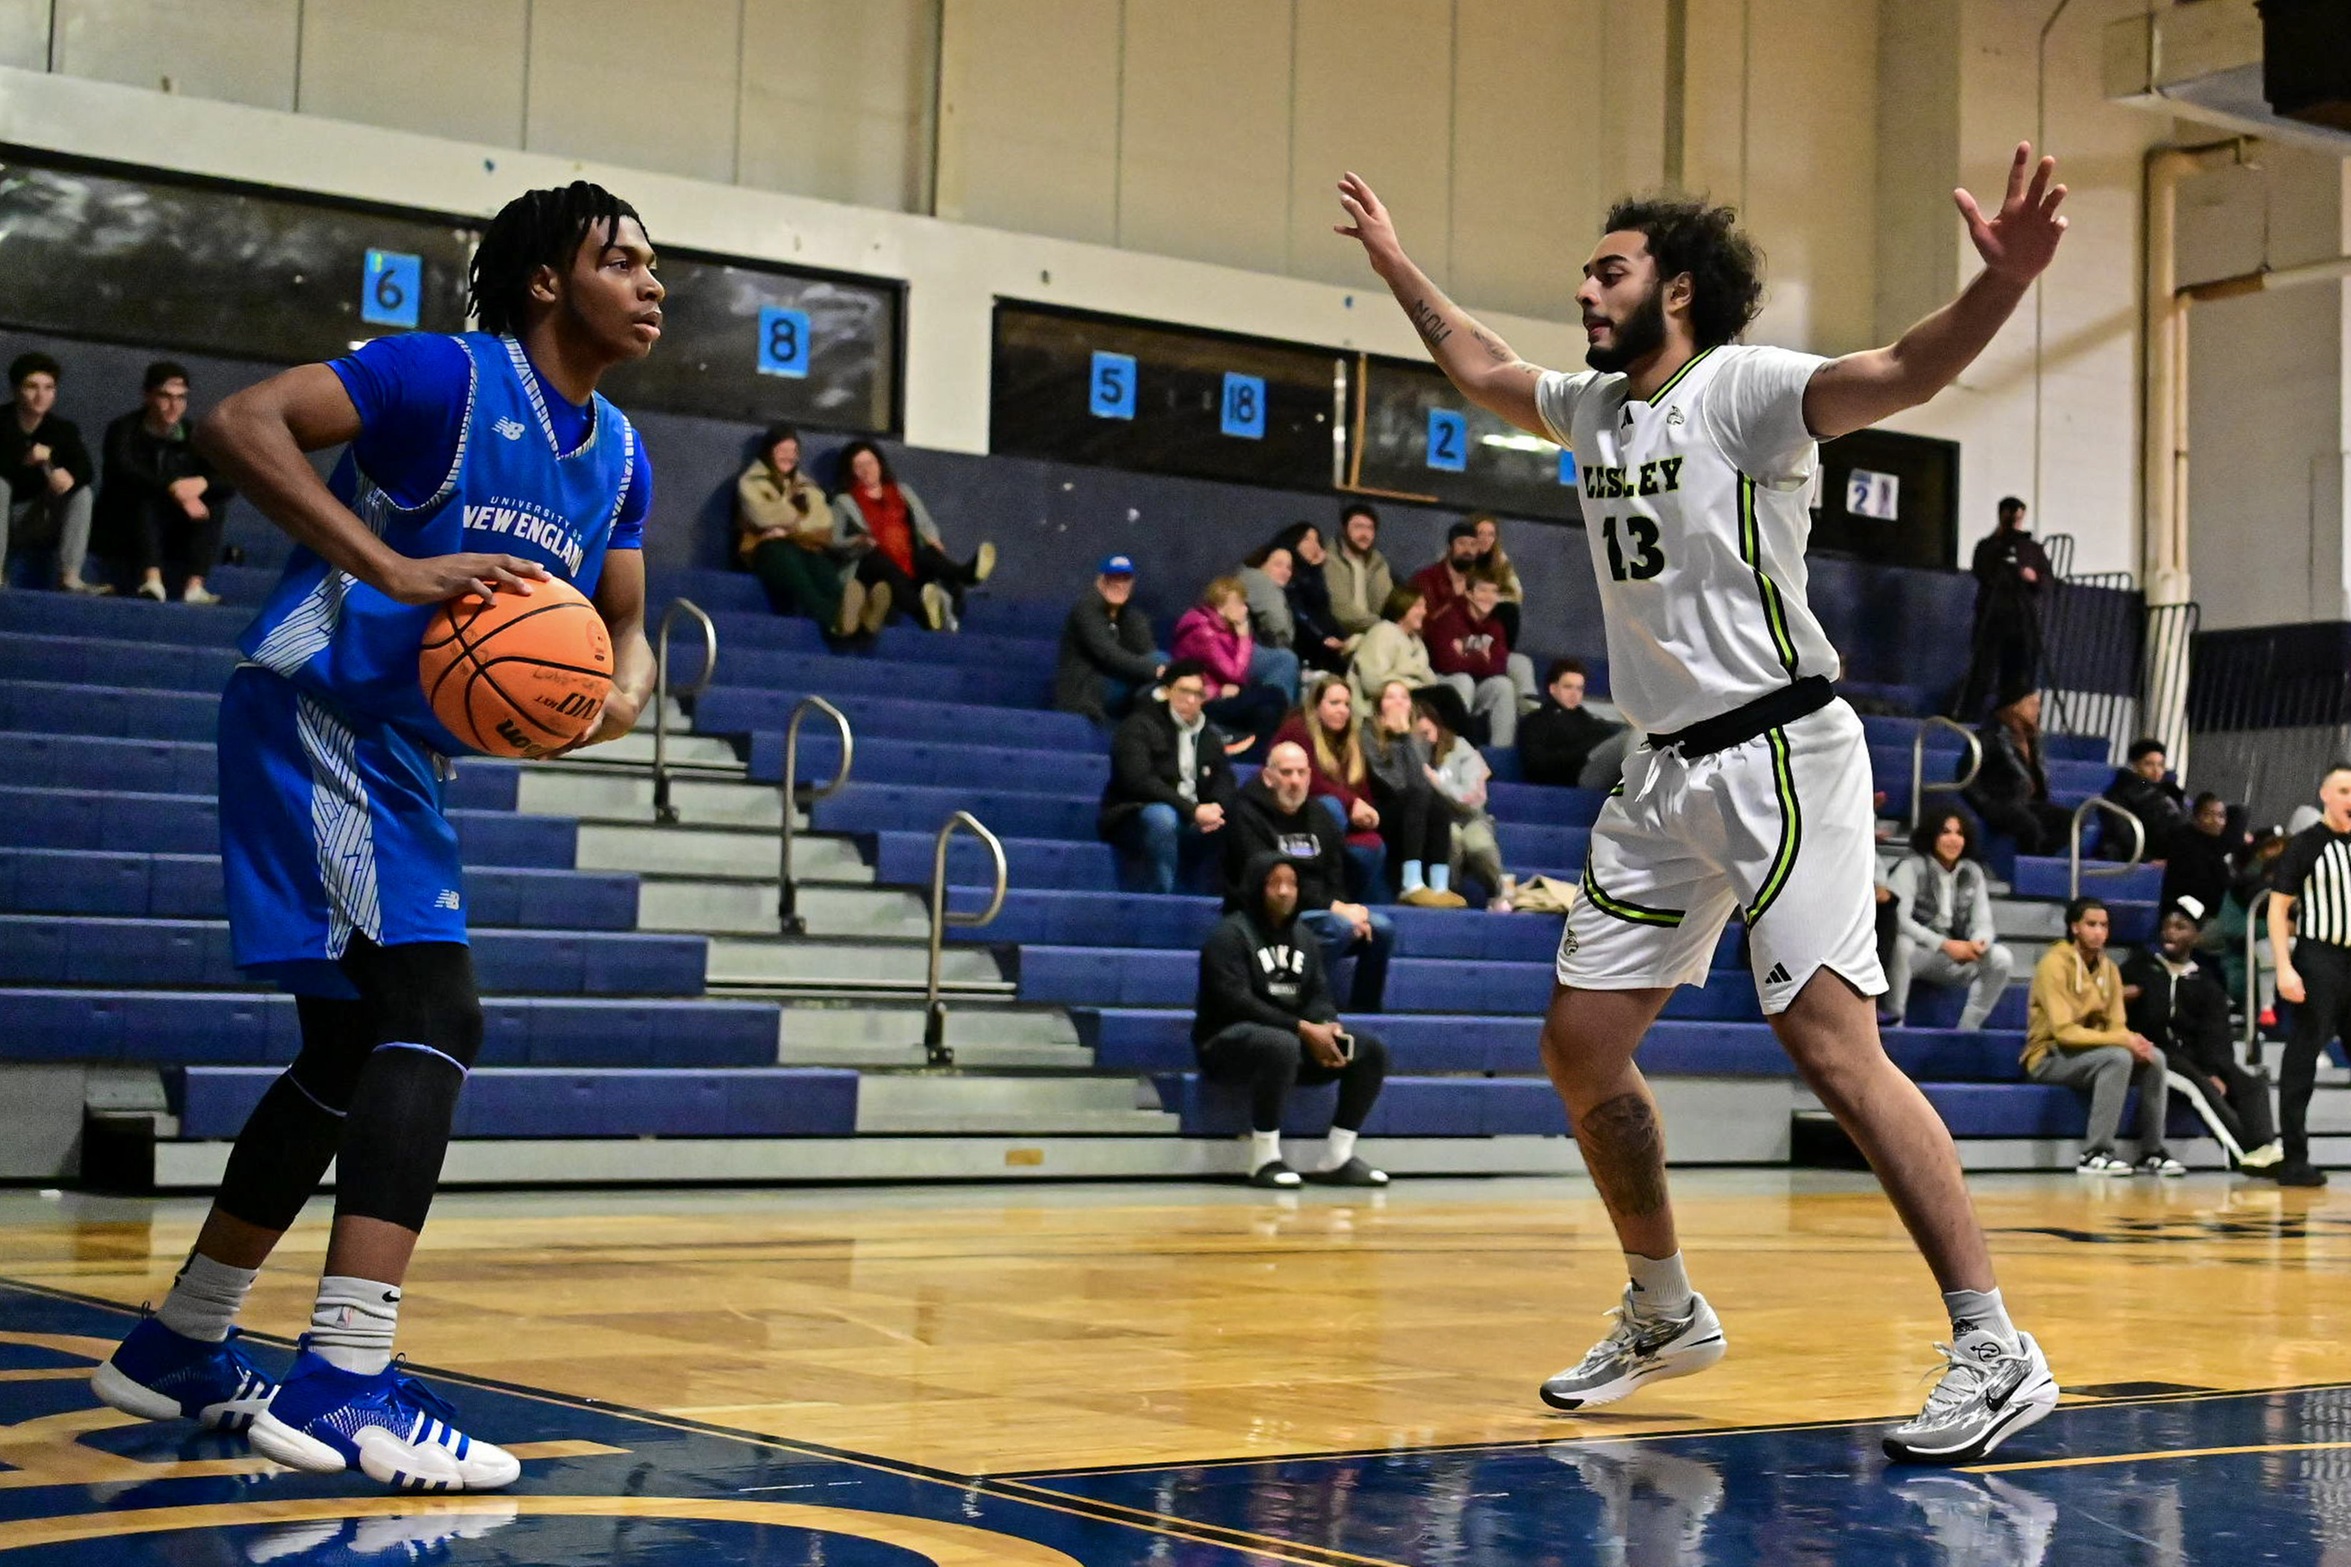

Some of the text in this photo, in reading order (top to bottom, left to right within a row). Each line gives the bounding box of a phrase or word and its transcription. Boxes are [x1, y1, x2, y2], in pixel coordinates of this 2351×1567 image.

[376, 268, 403, 311] 6
[769, 317, 796, 362] 8
[1101, 368, 1122, 404] 5
[1229, 384, 1255, 423] 18
[1437, 422, 1456, 459] 2
[1582, 456, 1683, 499] LESLEY
[491, 495, 583, 542] UNIVERSITY OF
[513, 512, 584, 578] ENGLAN
[1602, 516, 1665, 581] 13
